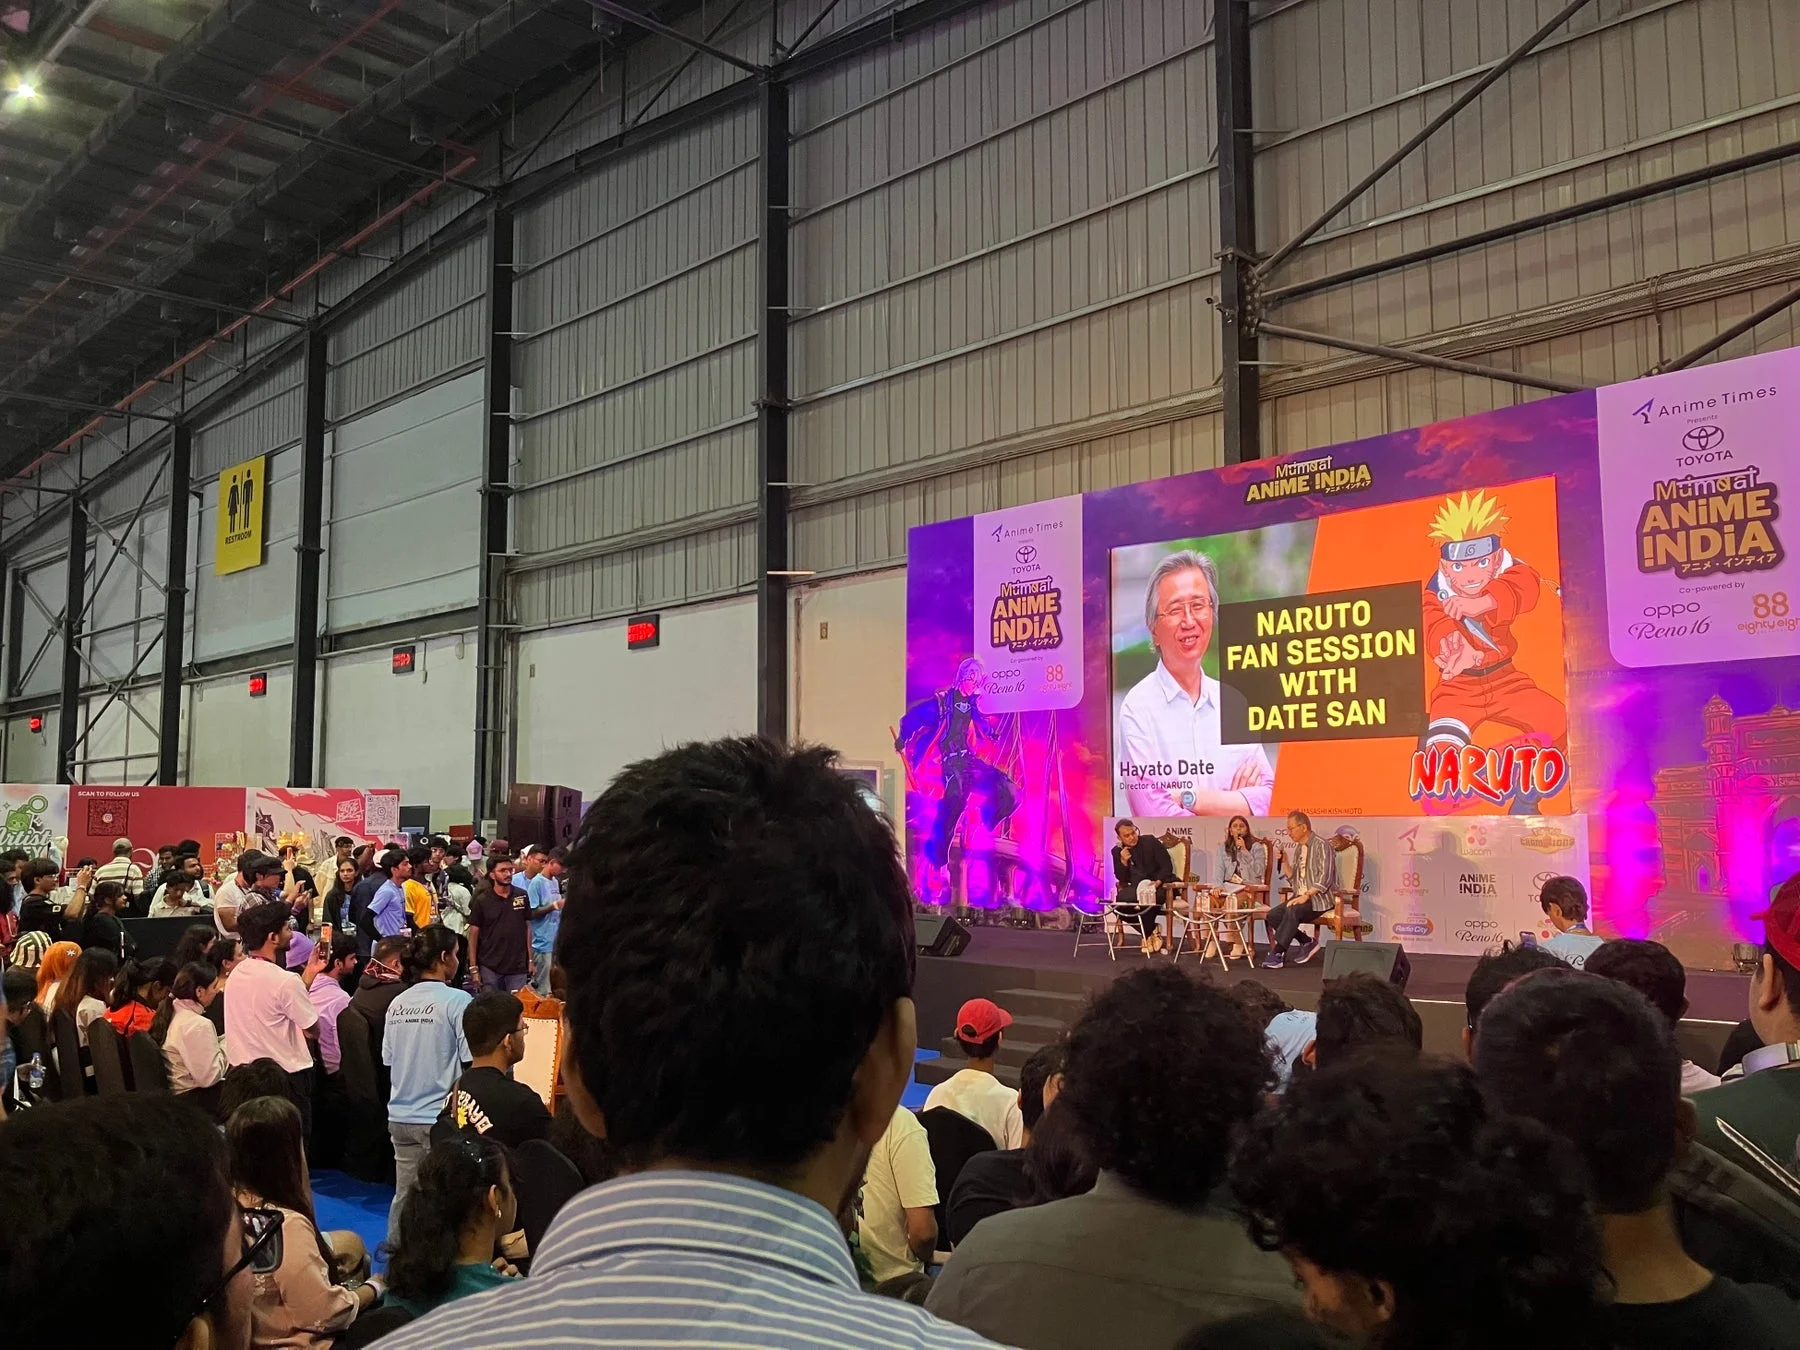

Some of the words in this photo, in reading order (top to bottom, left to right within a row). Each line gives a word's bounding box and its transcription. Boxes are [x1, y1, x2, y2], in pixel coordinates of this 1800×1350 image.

[1658, 398, 1717, 418] Anime
[1722, 386, 1777, 405] Times
[1687, 414, 1718, 424] Presents
[1676, 450, 1733, 467] TOYOTA
[225, 530, 252, 545] RESTROOM
[1004, 527, 1034, 538] Anime
[1036, 521, 1063, 532] Times
[1012, 564, 1041, 574] TOYOTA
[1679, 582, 1733, 594] Co-powered
[1735, 581, 1745, 590] by
[1643, 602, 1701, 619] oppo
[1753, 592, 1789, 618] 88
[1257, 600, 1371, 637] NARUTO
[1737, 620, 1775, 635] eighty
[1777, 617, 1800, 632] eigh
[1628, 622, 1688, 640] Reno
[1690, 616, 1712, 634] 16
[1227, 642, 1279, 670] FAN
[1287, 628, 1415, 666] SESSION
[992, 669, 1021, 679] oppo
[1046, 664, 1063, 682] 88
[1280, 667, 1357, 698] WITH
[1248, 702, 1318, 731] DATE
[1326, 698, 1386, 727] SAN
[1120, 760, 1172, 780] Hayato
[1178, 759, 1215, 775] Date
[1409, 744, 1567, 804] NARUTO
[1120, 781, 1149, 790] Director
[1151, 781, 1159, 789] of
[1160, 780, 1193, 789] NARUTO
[1402, 871, 1420, 887] 88
[1395, 925, 1413, 933] Radio
[1414, 925, 1428, 934] City
[1464, 920, 1499, 930] oppo
[1455, 930, 1491, 942] Reno
